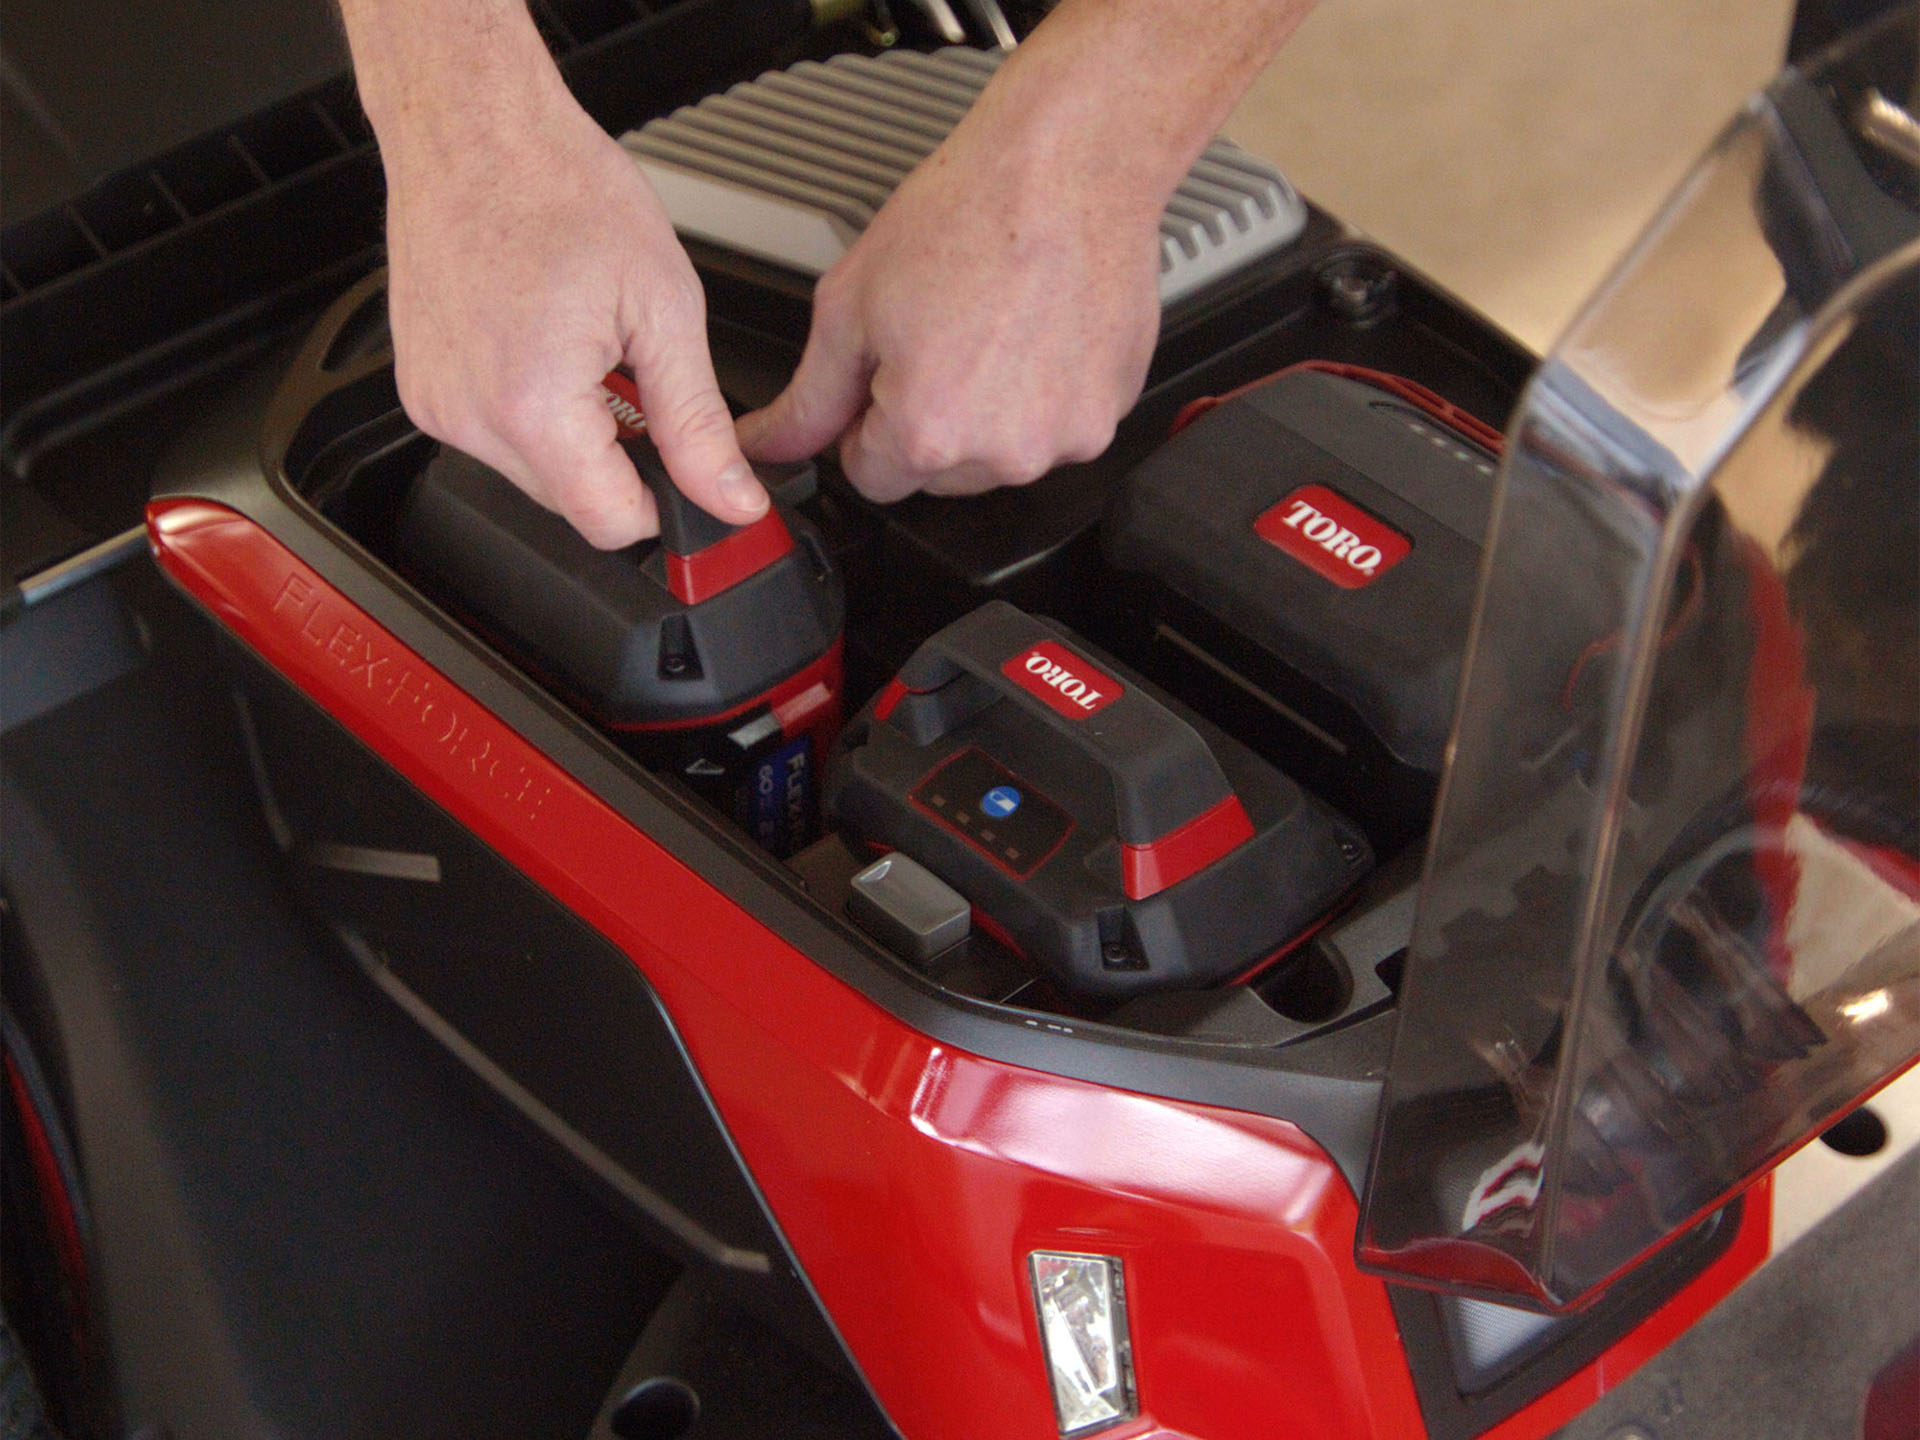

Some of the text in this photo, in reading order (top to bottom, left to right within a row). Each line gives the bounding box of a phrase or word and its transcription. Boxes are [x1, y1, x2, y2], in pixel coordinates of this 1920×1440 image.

[604, 390, 647, 428] ORO
[1282, 500, 1382, 572] TORO
[1025, 654, 1103, 710] TORO
